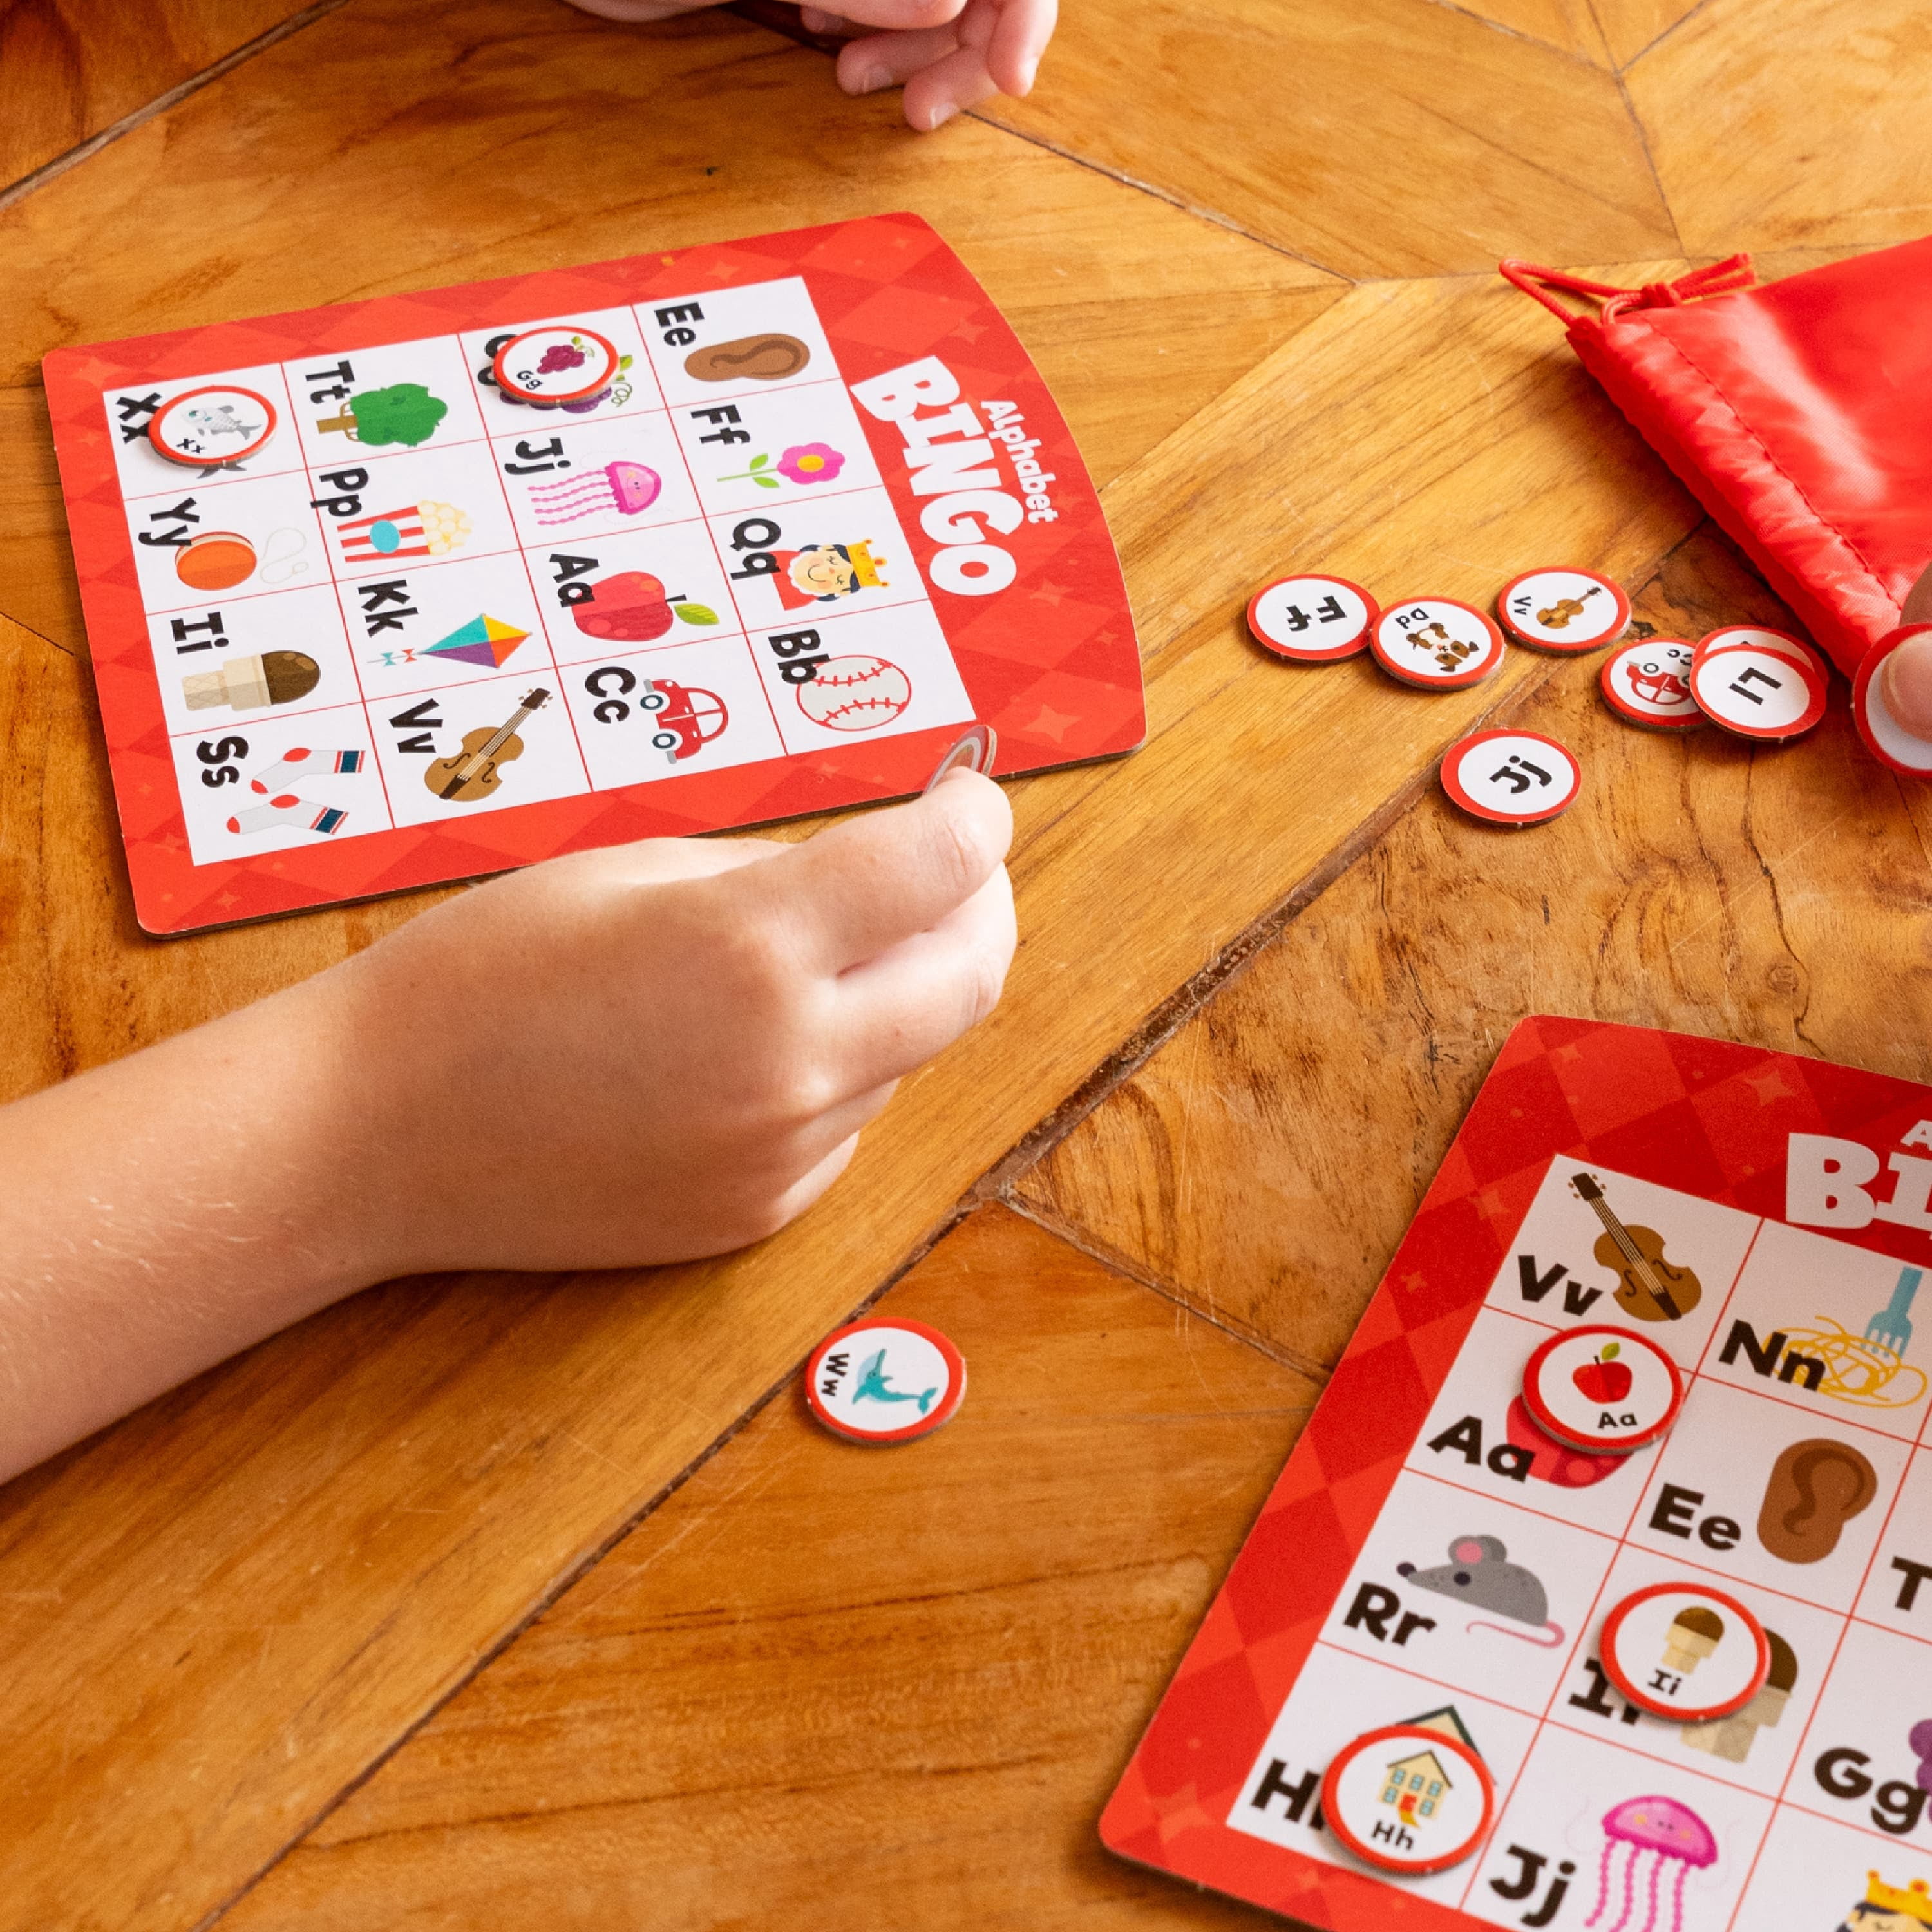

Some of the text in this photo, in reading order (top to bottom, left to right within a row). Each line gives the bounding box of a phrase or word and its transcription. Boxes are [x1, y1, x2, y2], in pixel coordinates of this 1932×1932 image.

[655, 302, 705, 346] Ee
[305, 360, 355, 404] Tt
[517, 370, 542, 390] Gg
[690, 404, 750, 444] Ff
[504, 438, 571, 475] Jj
[849, 355, 1024, 596] BINGO
[980, 400, 1058, 524] Alphabet
[310, 468, 368, 517] Pp
[138, 497, 200, 547] Yy
[730, 518, 781, 580] Qq
[549, 554, 599, 607] Aa
[1514, 596, 1531, 615] Vv
[170, 612, 229, 655] Ii
[358, 580, 418, 637] Kk
[1286, 596, 1346, 632] Ff
[1395, 607, 1428, 629] Dd
[768, 629, 831, 684] Bb
[585, 667, 636, 724] Cc
[389, 699, 443, 753] Vv
[196, 736, 249, 788] Ss
[1490, 755, 1552, 794] Jj
[1786, 1133, 1932, 1240] BI
[1518, 1255, 1603, 1316] Vv
[822, 1354, 849, 1396] Ww
[1719, 1319, 1826, 1392] Nn
[1598, 1412, 1638, 1429] Aa
[1427, 1416, 1533, 1482] Aa
[1649, 1483, 1741, 1551] Ee
[1344, 1582, 1436, 1645] Rr
[1569, 1658, 1642, 1725] I
[1649, 1670, 1681, 1694] Ii
[1251, 1759, 1325, 1831] H
[1815, 1748, 1930, 1835] Gg
[1372, 1822, 1412, 1849] Hh
[1490, 1845, 1575, 1927] Jj
